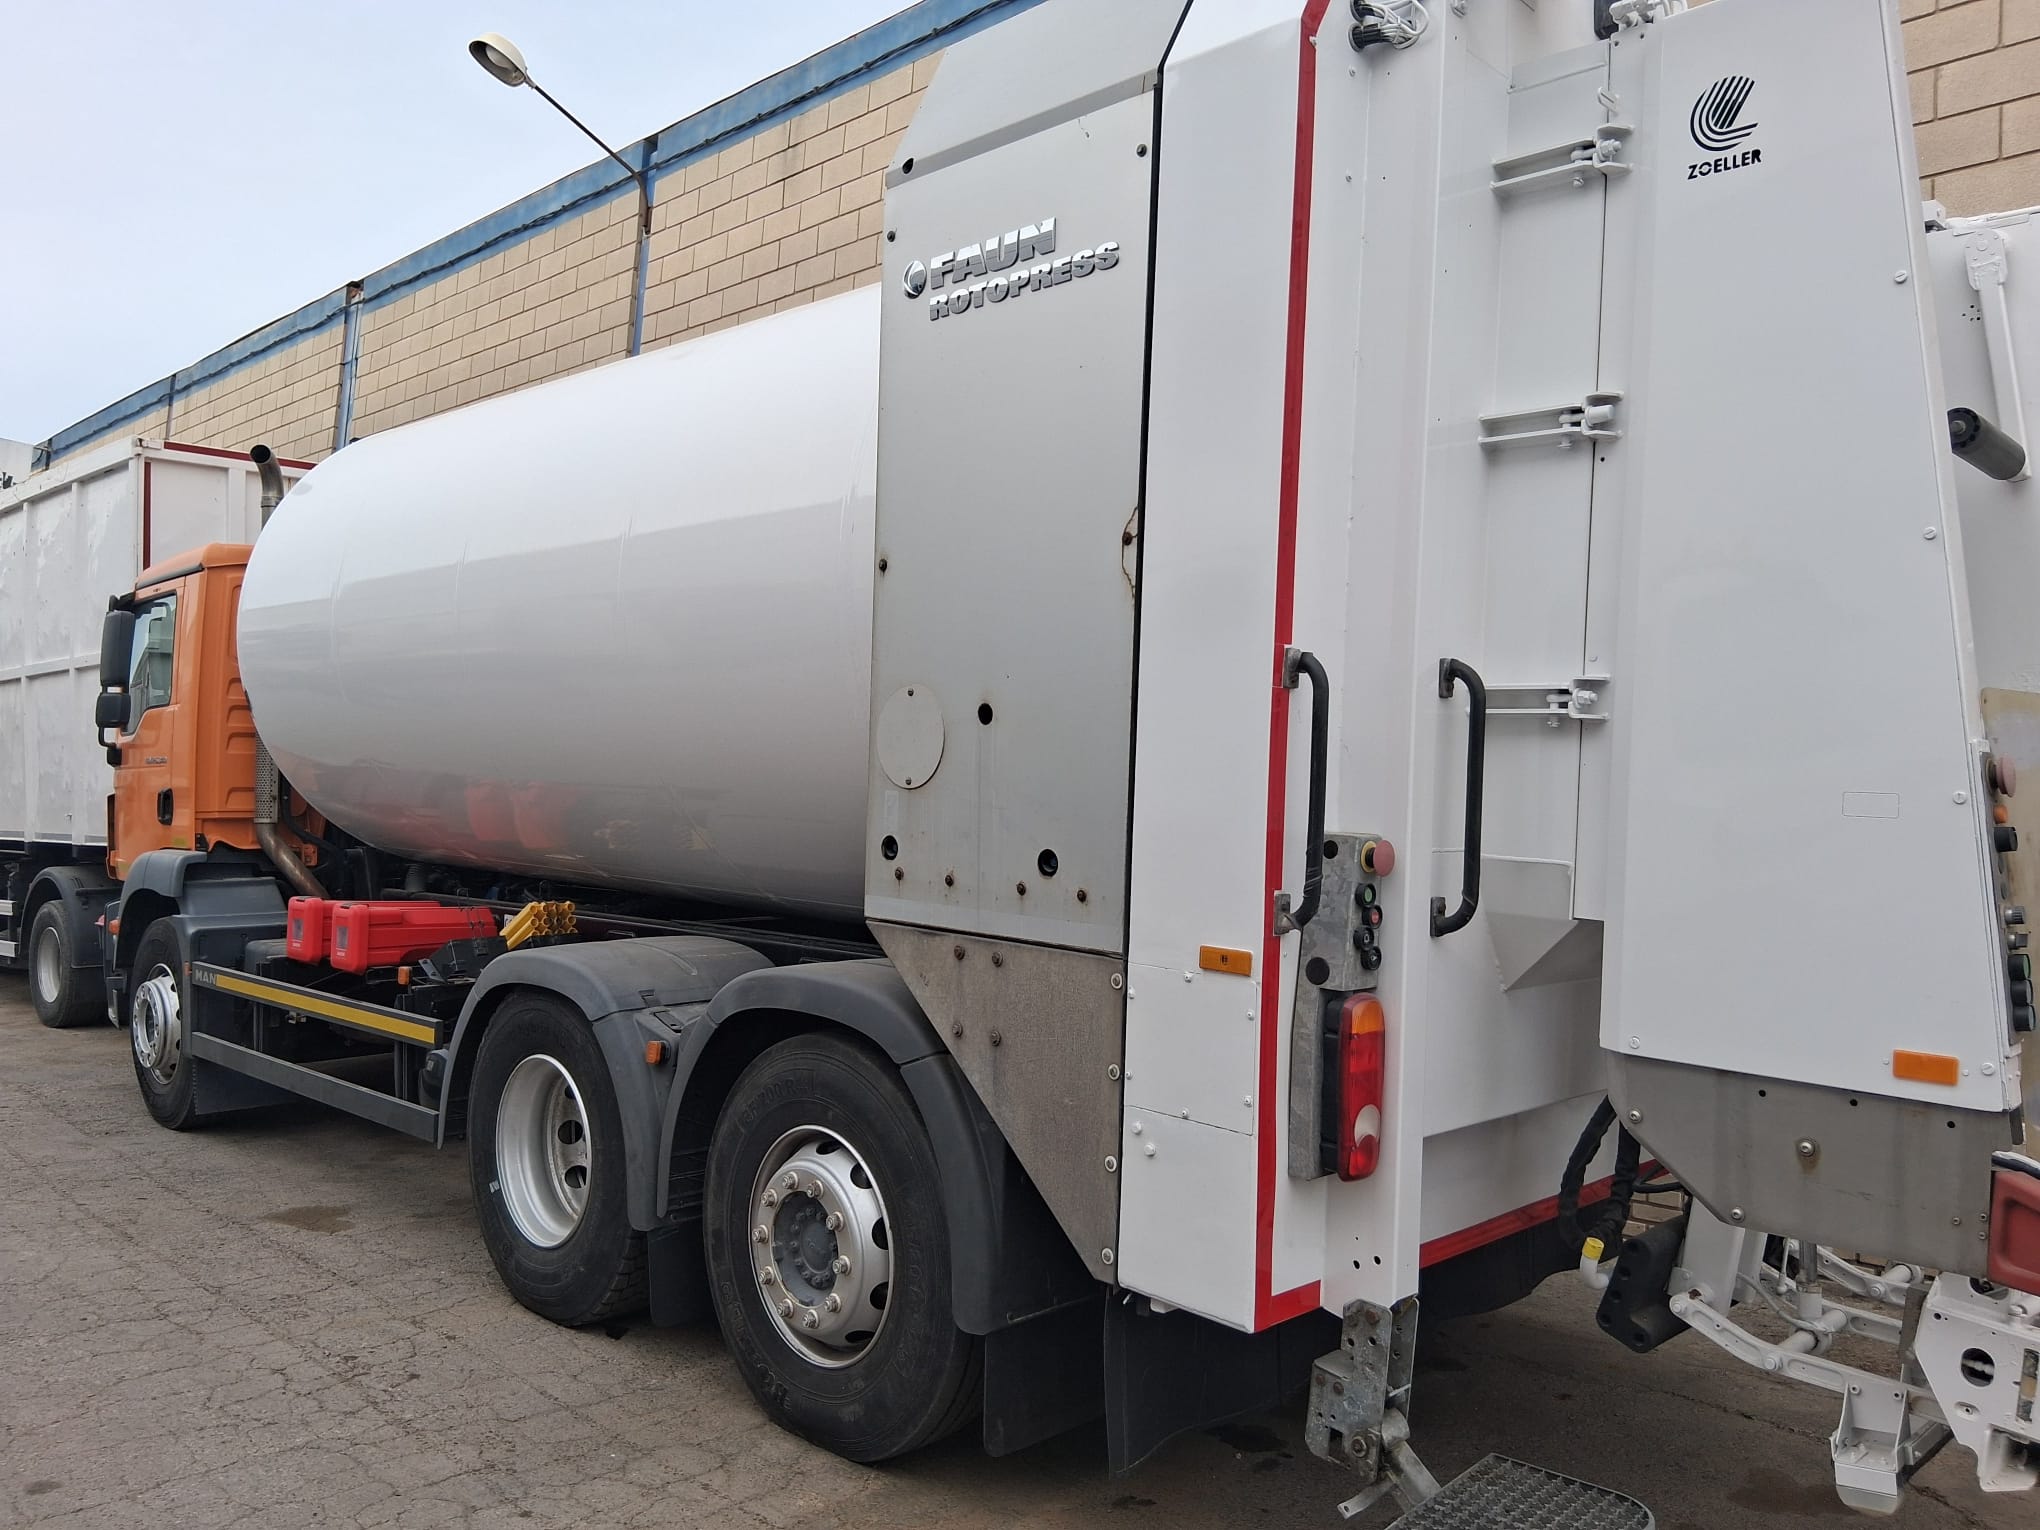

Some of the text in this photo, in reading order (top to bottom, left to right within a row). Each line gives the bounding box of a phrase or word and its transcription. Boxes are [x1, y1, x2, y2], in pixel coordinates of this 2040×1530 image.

[1687, 149, 1761, 180] ZOELLER
[931, 217, 1056, 289] FAUN
[929, 242, 1120, 321] ROTOPRESS
[195, 968, 216, 985] MAN
